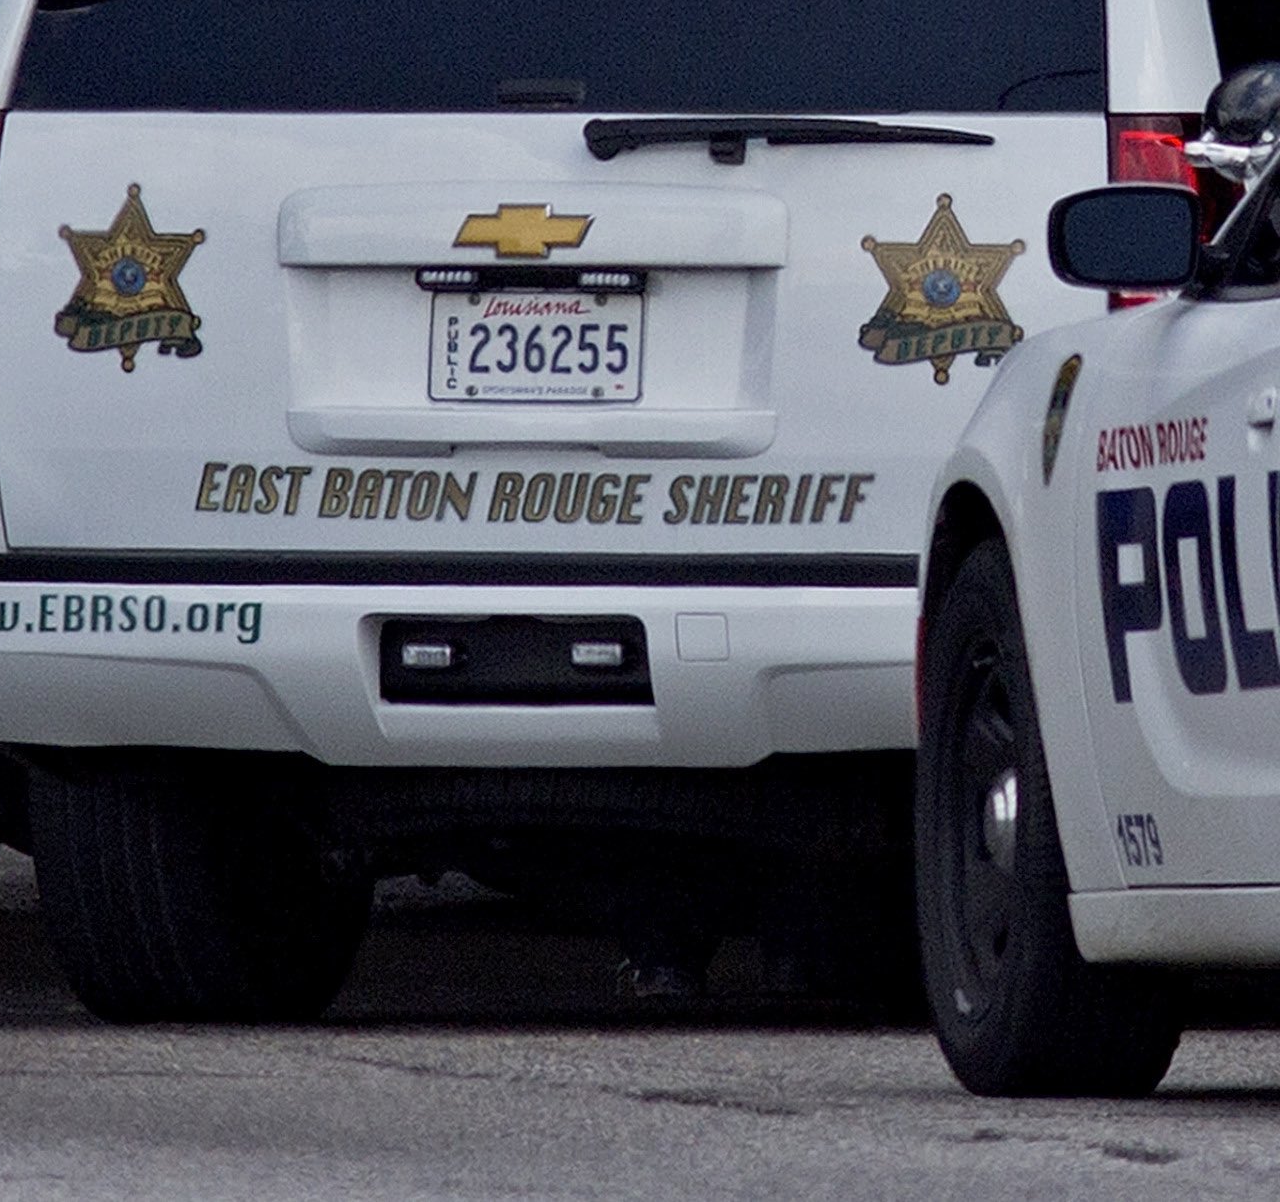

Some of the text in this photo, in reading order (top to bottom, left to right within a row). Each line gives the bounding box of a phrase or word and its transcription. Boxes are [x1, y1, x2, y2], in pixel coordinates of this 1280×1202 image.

[87, 314, 183, 348] DEPUTY
[483, 297, 591, 318] Louisiana
[446, 316, 459, 390] PUBLIC
[468, 322, 629, 375] 236255
[897, 325, 1002, 360] DEPUTY
[1096, 417, 1209, 472] BATON ROUGE
[195, 462, 876, 525] EAST BATON ROUGE SHERIFF
[1117, 812, 1164, 866] 1579
